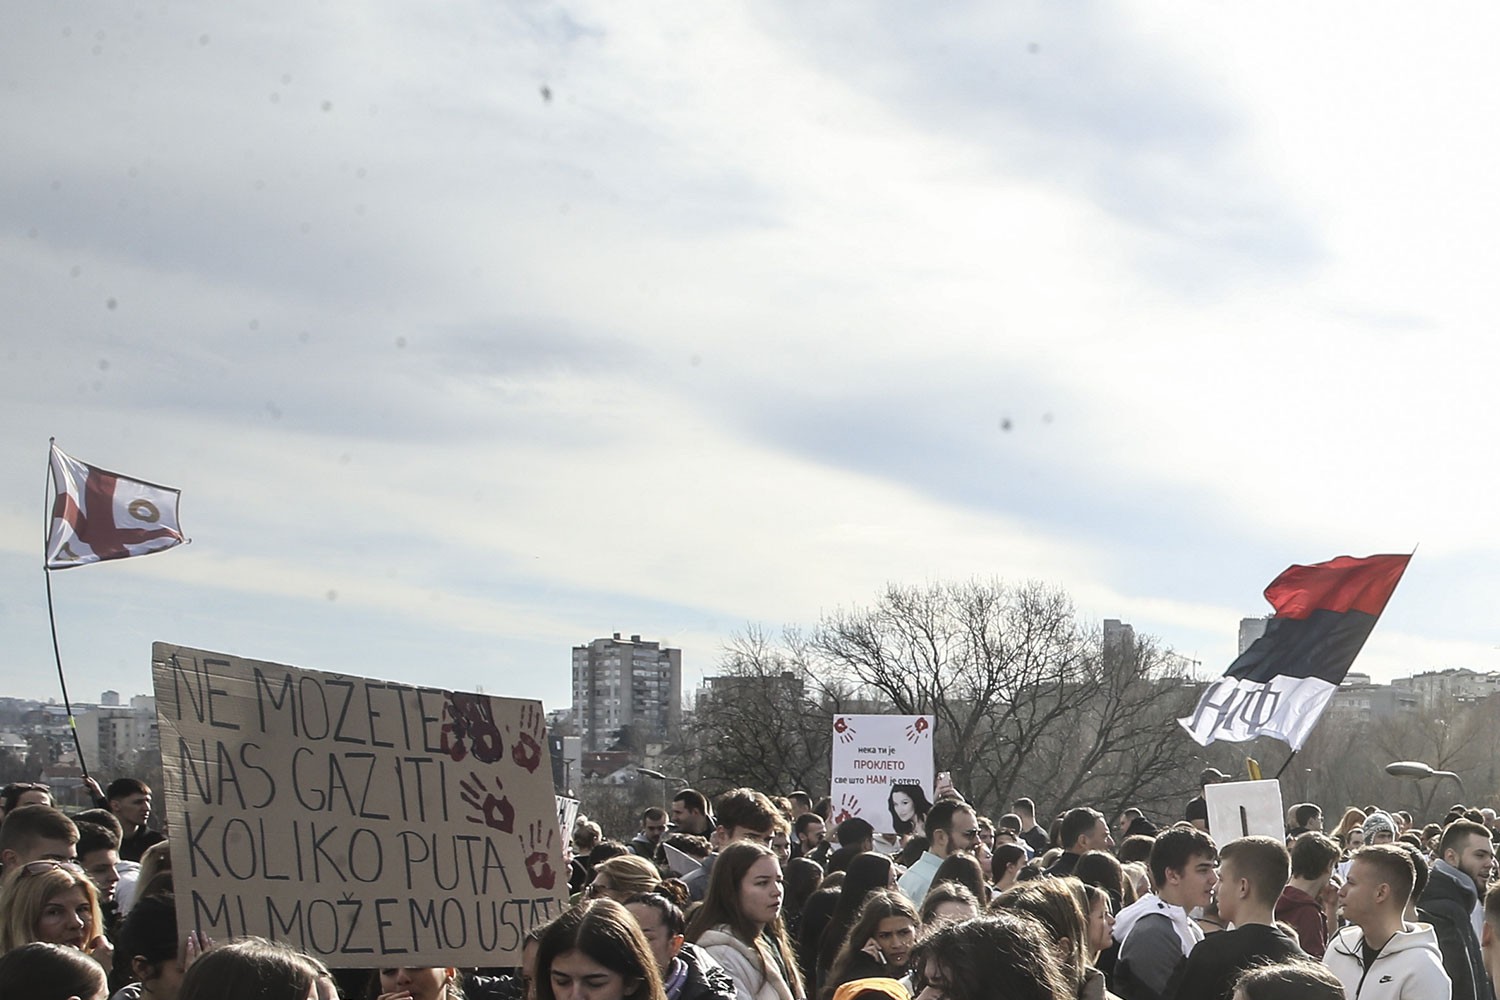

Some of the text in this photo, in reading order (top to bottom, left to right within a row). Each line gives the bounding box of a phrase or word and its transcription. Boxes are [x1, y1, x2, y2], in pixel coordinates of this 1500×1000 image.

[169, 653, 243, 731] NE
[179, 740, 276, 810] NAS
[853, 760, 905, 770] ПРОКЛЕТО
[866, 775, 887, 784] НАМ
[185, 812, 512, 895] KOLIKO PUTA
